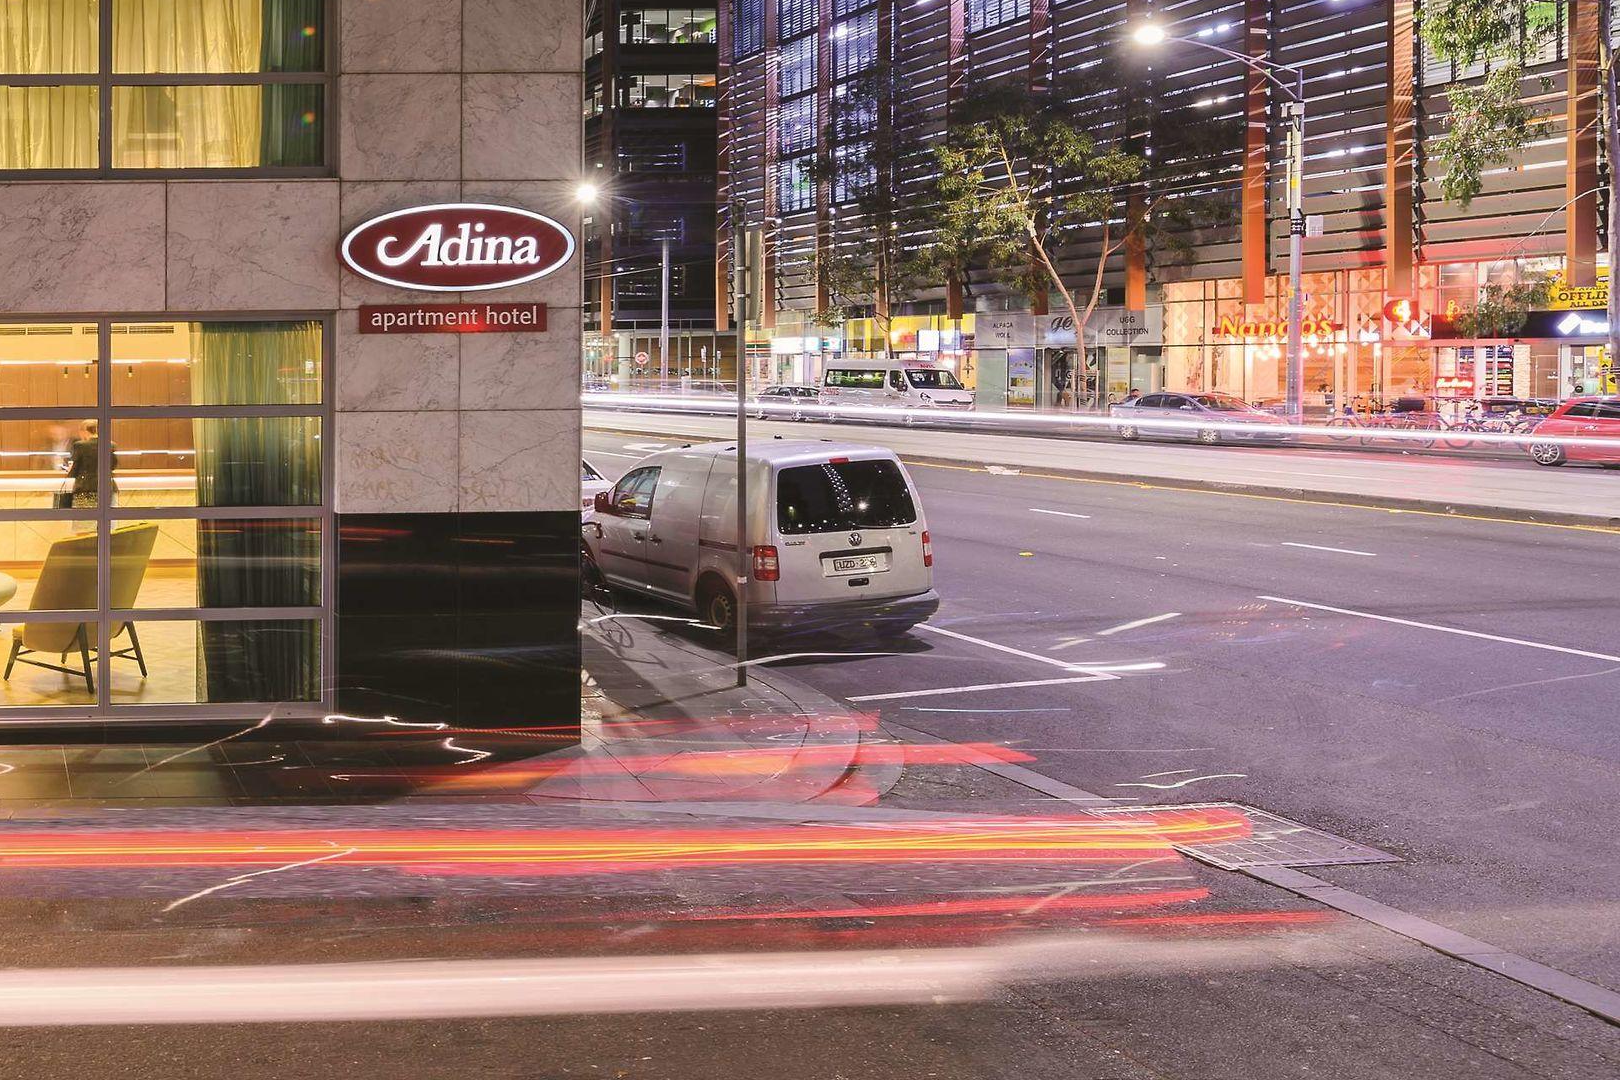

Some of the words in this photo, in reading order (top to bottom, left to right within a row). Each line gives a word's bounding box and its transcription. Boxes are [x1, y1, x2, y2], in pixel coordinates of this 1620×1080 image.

[377, 222, 540, 266] Adina
[371, 308, 478, 332] apartment
[485, 305, 538, 326] hotel
[1105, 327, 1149, 336] COLLECTION
